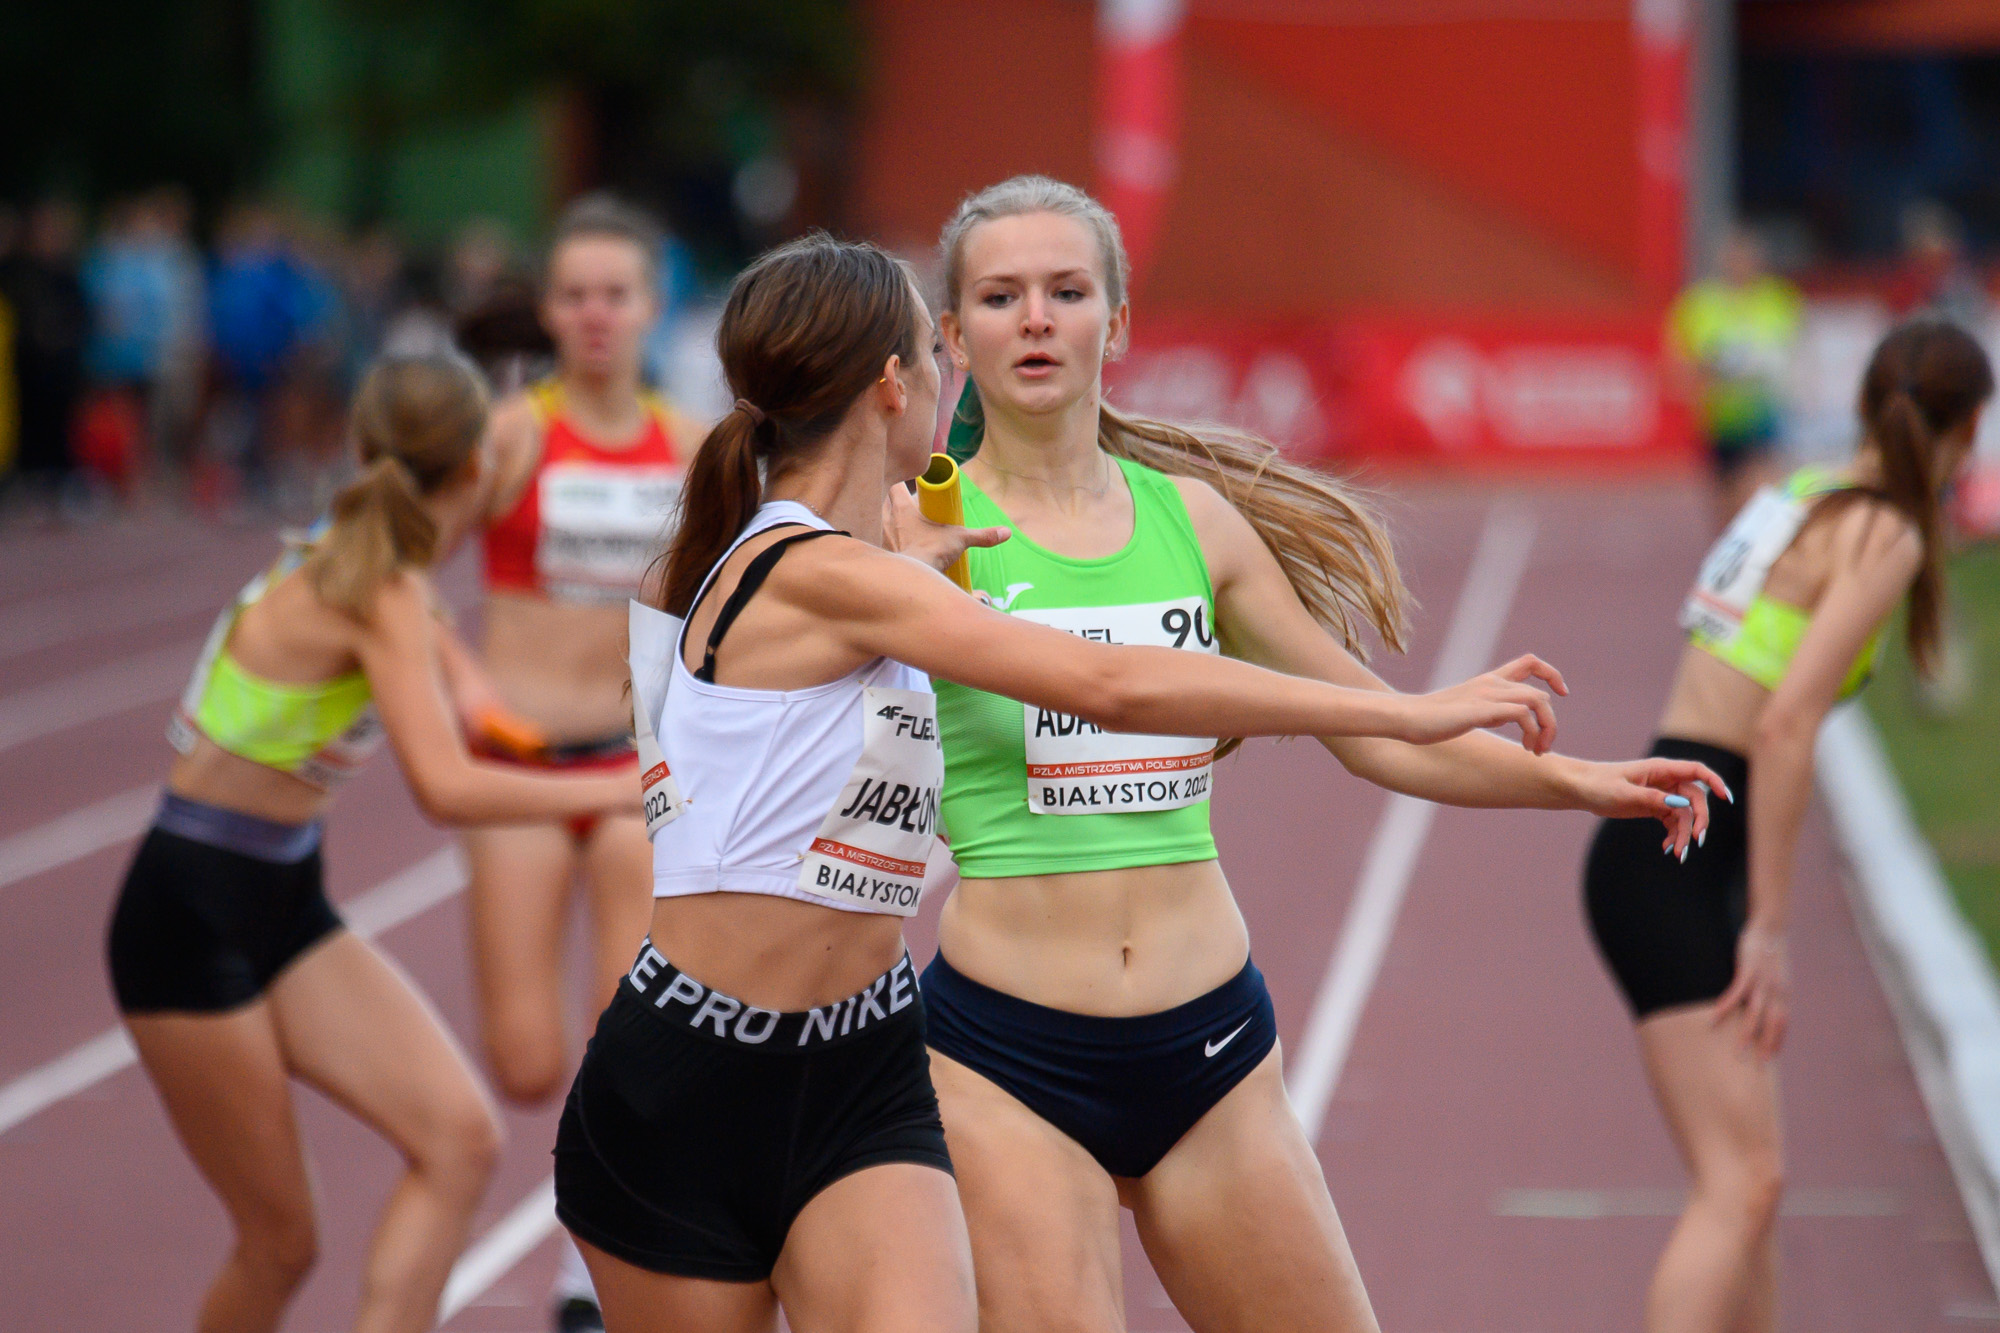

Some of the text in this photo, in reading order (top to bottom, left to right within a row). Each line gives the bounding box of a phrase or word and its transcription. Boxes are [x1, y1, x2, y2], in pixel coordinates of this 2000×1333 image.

[1033, 767, 1062, 776] PZLA
[1064, 762, 1144, 775] MISTRZOSTWA
[1145, 760, 1180, 770] POLSKI
[1042, 772, 1208, 807] BIAŁYSTOK 2022
[646, 791, 672, 827] 022
[818, 842, 845, 857] PZLA
[846, 850, 909, 873] MISTRZOSTWA
[654, 973, 780, 1045] PRO
[797, 957, 913, 1047] NIKE
